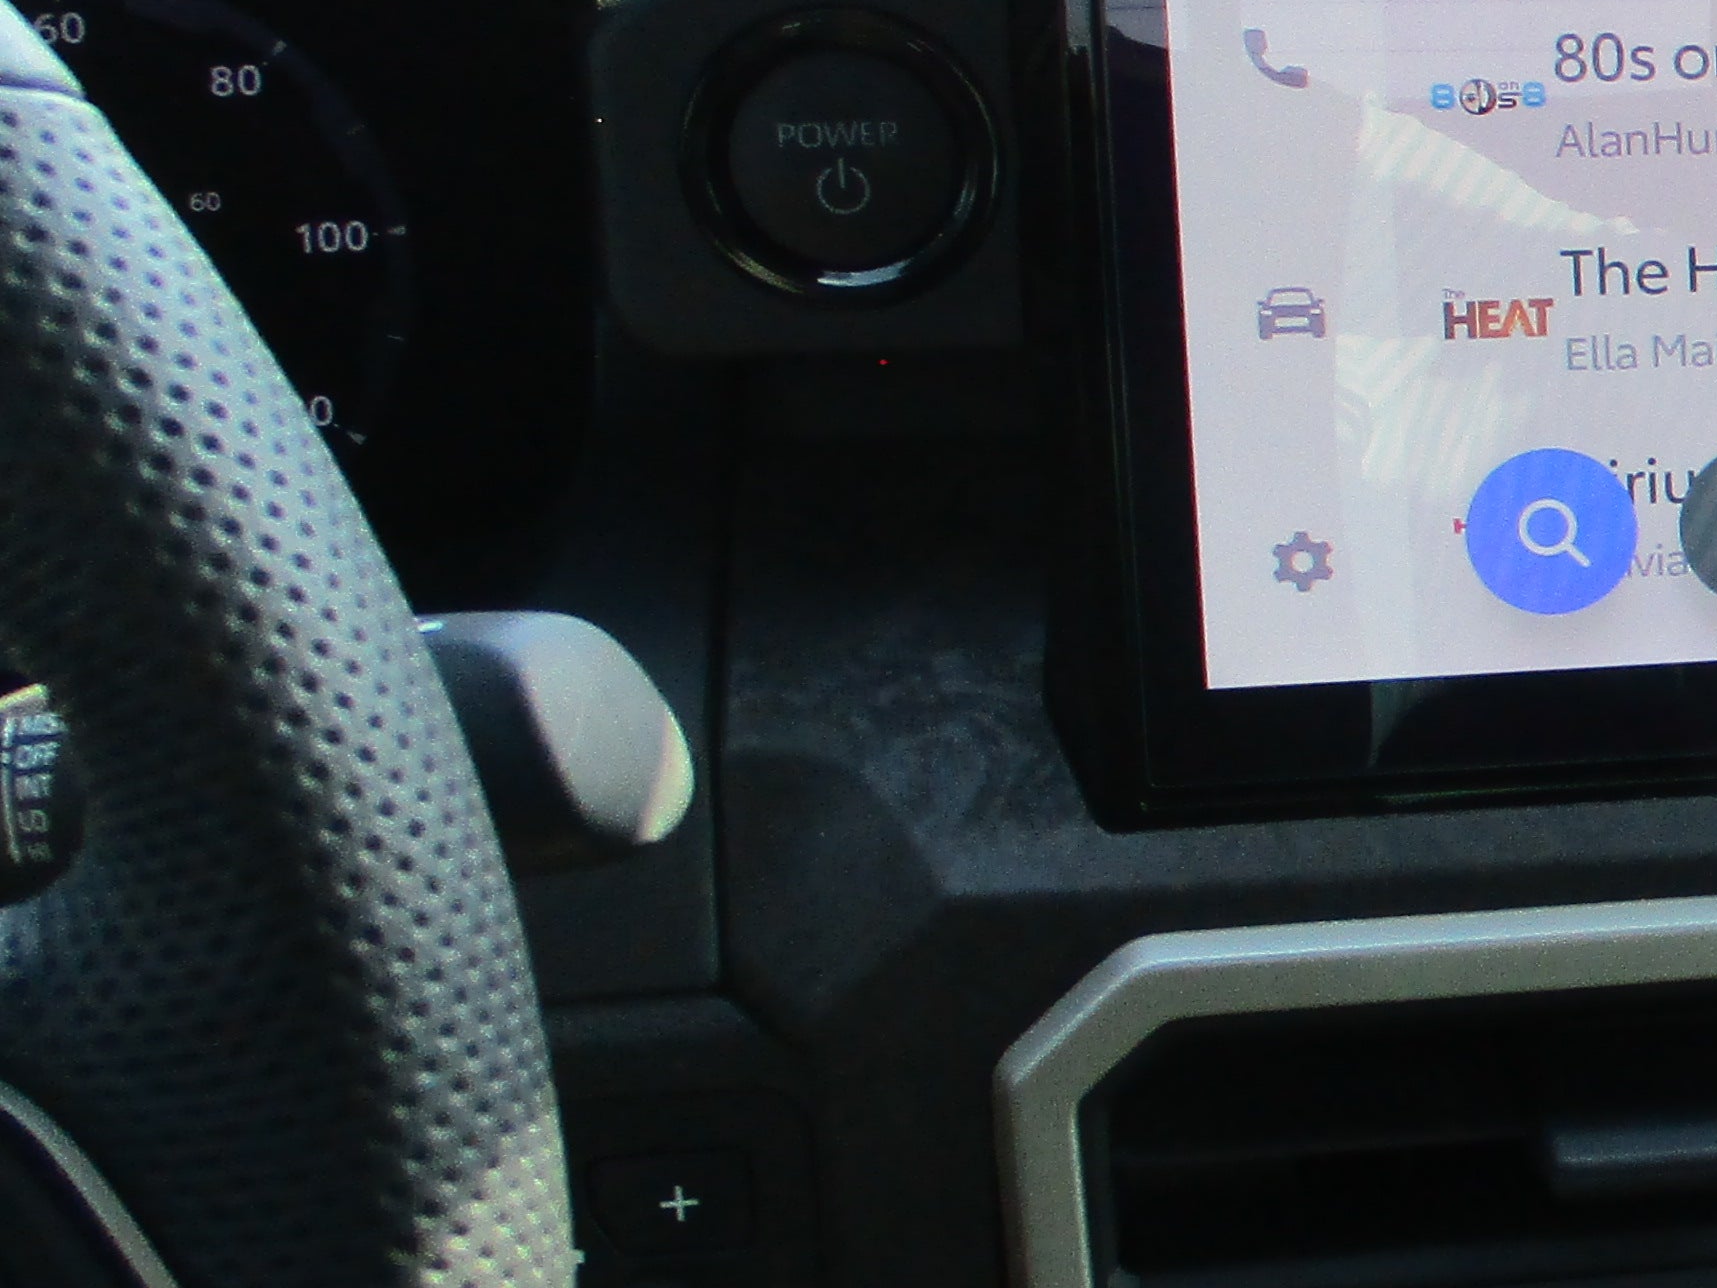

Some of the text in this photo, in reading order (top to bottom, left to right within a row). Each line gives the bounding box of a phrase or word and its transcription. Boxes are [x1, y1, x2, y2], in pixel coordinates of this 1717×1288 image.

[33, 11, 87, 45] 60
[1553, 33, 1657, 83] 80s
[208, 64, 262, 97] 80
[777, 120, 899, 149] POWER
[188, 190, 222, 212] 60
[294, 219, 370, 255] 100
[1560, 248, 1669, 296] The
[1442, 297, 1554, 340] HEAT
[1565, 335, 1640, 372] Ella
